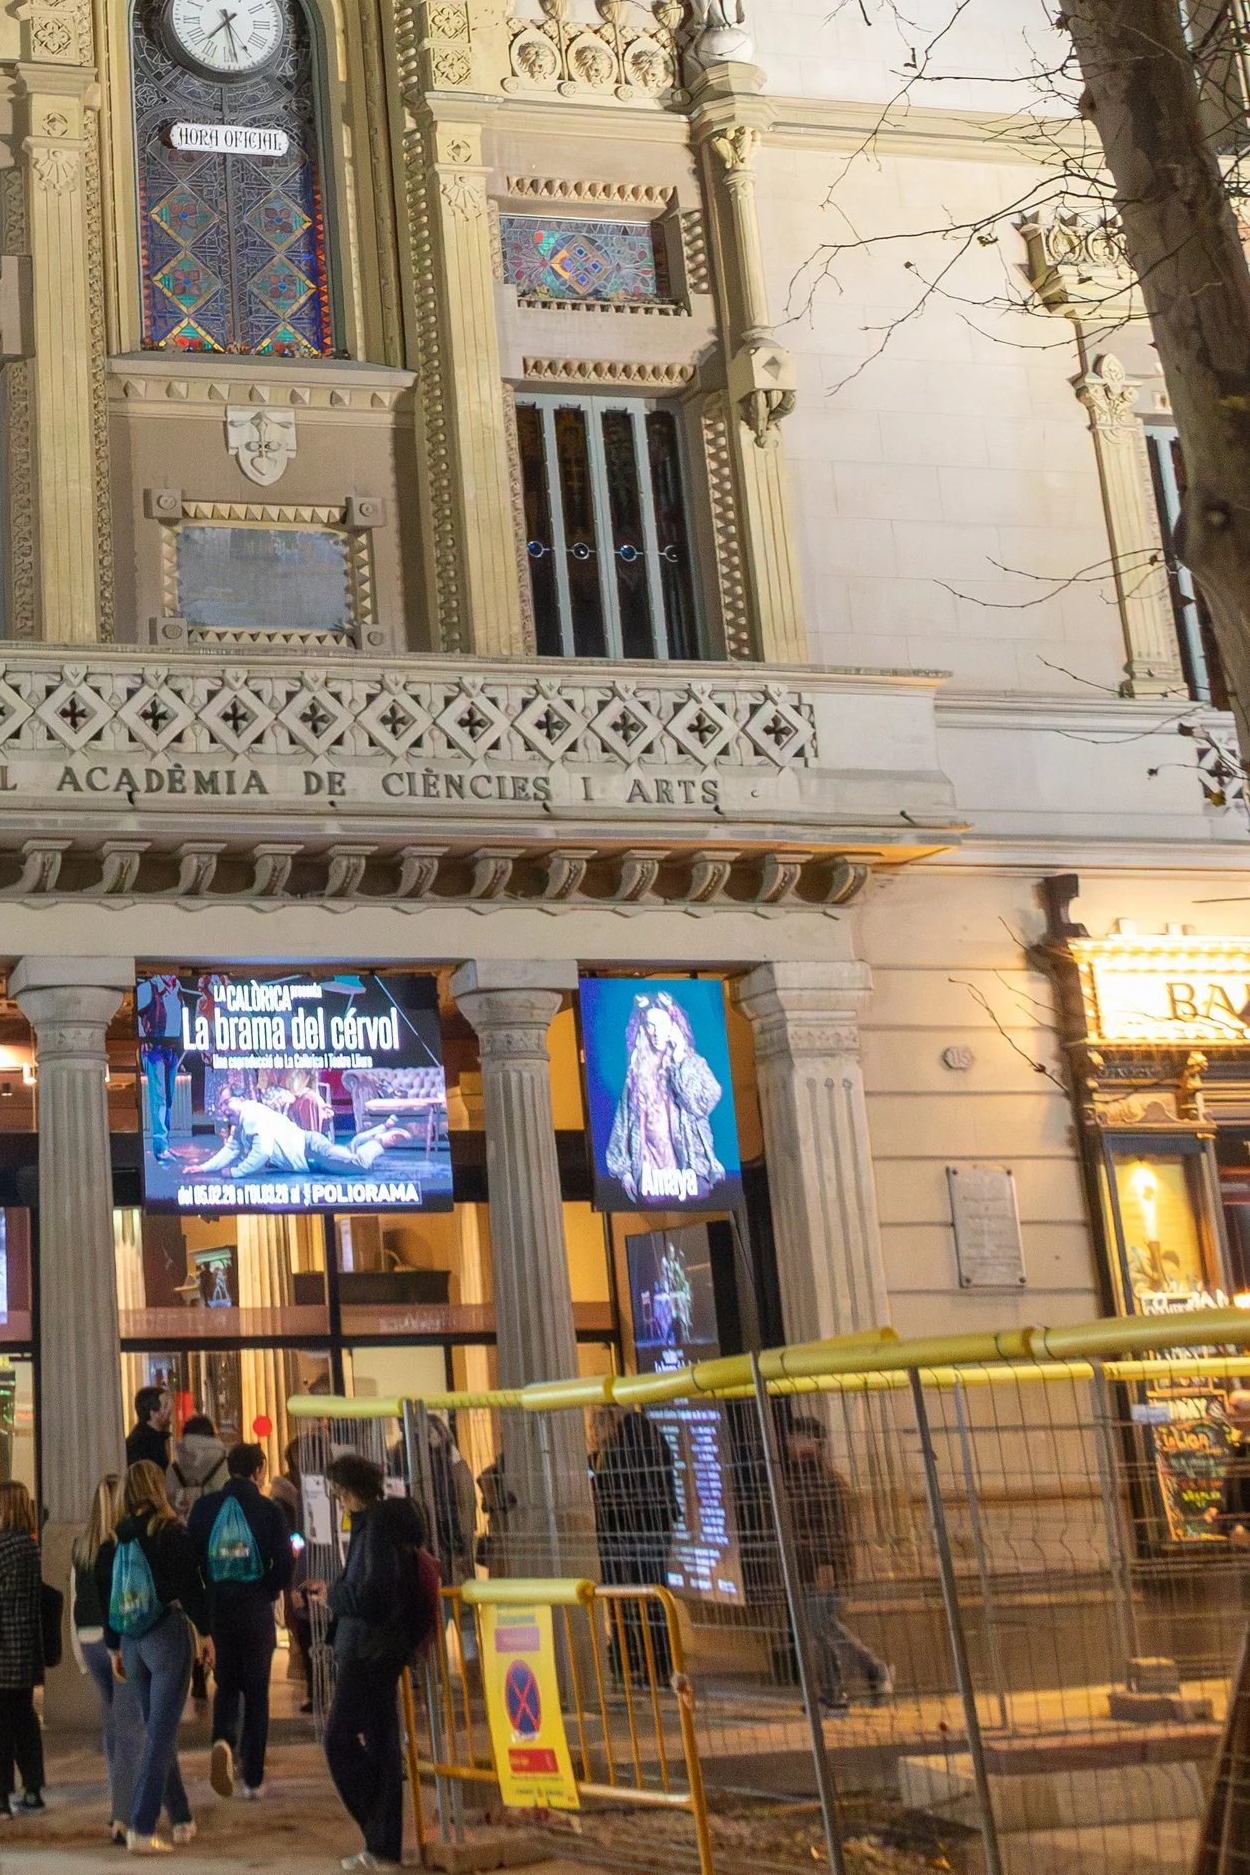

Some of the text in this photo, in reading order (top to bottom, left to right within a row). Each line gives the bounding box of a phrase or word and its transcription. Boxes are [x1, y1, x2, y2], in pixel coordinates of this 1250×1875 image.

[177, 127, 282, 151] HORA OFICIAL
[303, 771, 346, 796] DE
[381, 767, 550, 802] CIÈNCIES
[581, 776, 593, 801] I
[626, 778, 719, 805] ARTS
[214, 985, 227, 1002] LA
[226, 980, 292, 1011] CALÒRICA
[1165, 982, 1250, 1028] BA
[182, 1007, 399, 1050] La brama del cérvol
[312, 1182, 419, 1203] POLIORAMA
[642, 1162, 698, 1202] Amaya
